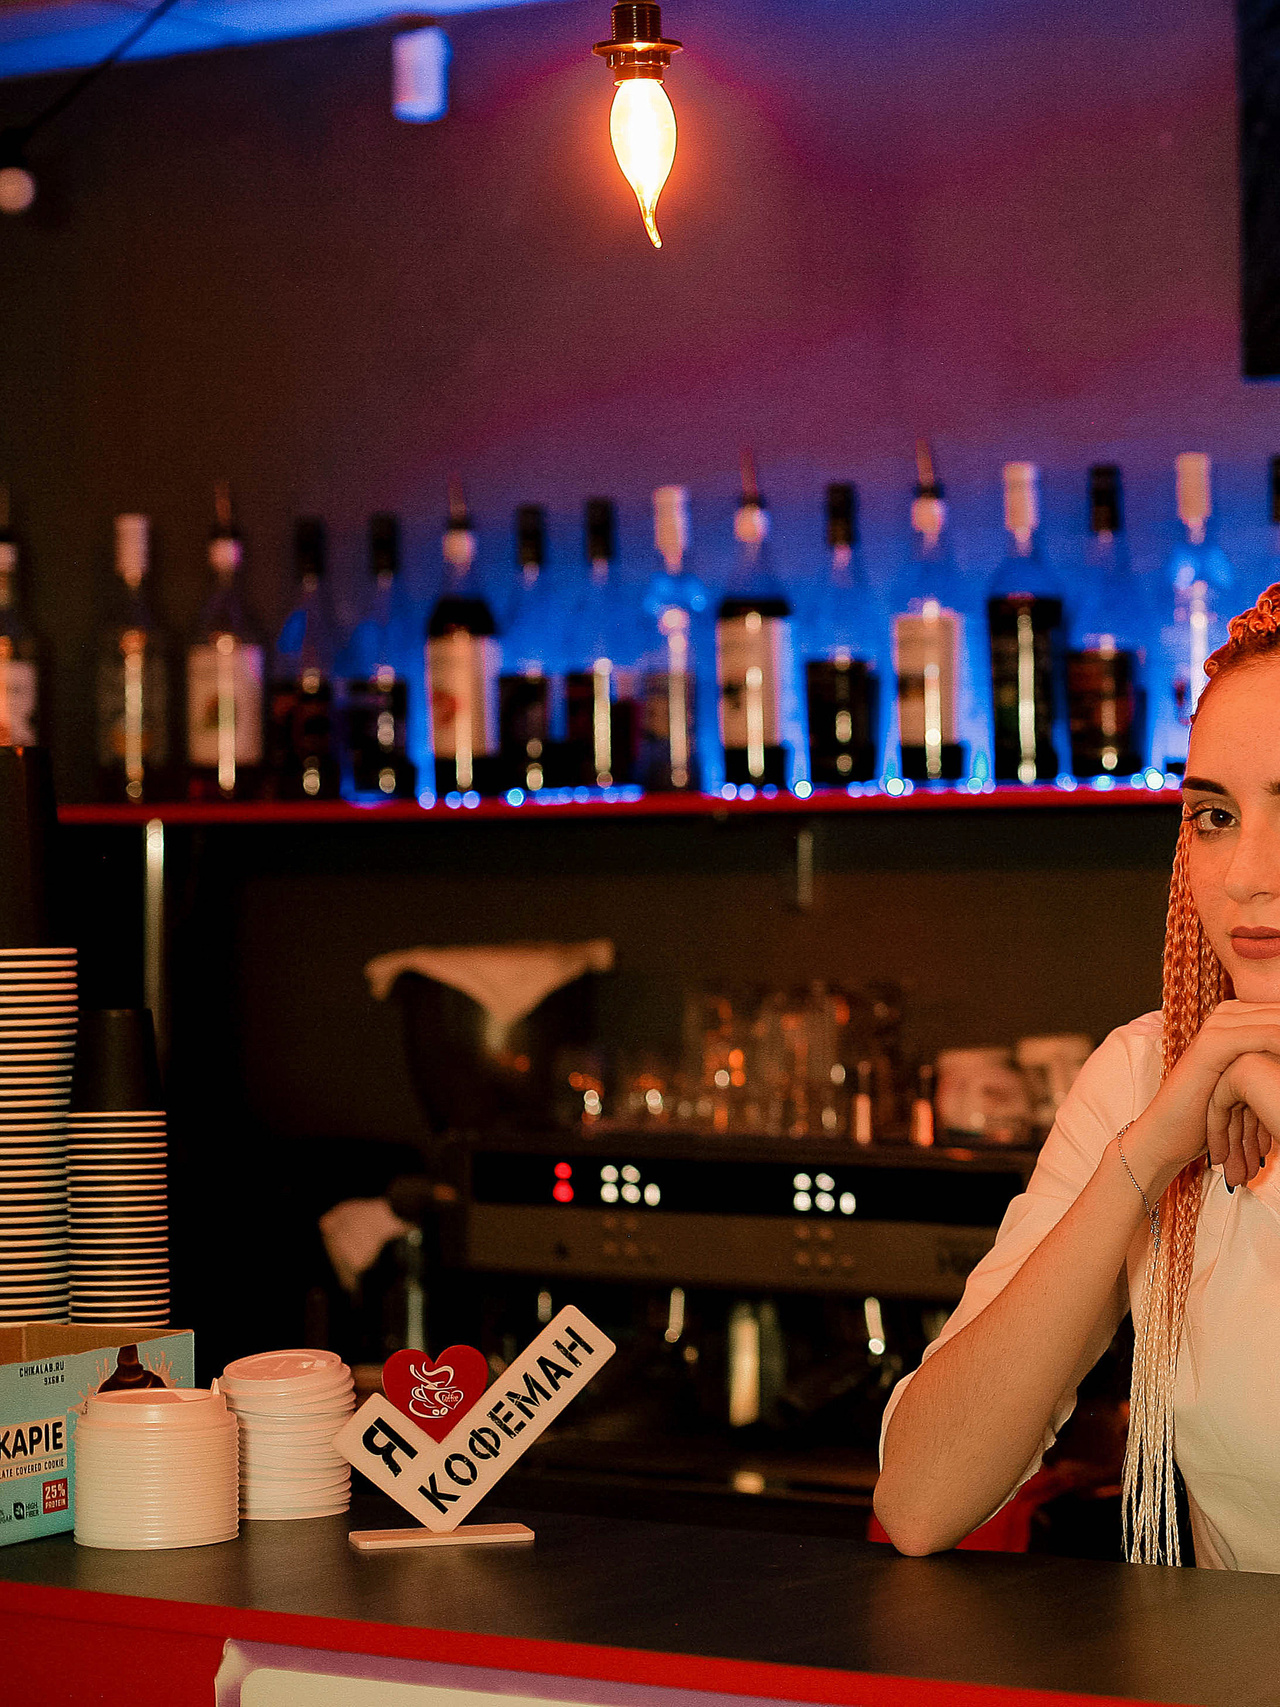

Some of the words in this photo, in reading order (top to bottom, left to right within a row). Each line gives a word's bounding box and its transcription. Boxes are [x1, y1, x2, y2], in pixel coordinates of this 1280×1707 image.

[19, 1360, 65, 1378] CHIKALAB.RU
[417, 1325, 595, 1515] КОФЕМАН
[361, 1416, 419, 1479] Я
[15, 1462, 42, 1476] COVERED
[44, 1457, 65, 1471] COOKIE
[44, 1482, 67, 1500] 25%
[26, 1501, 39, 1511] HIGH
[44, 1498, 67, 1510] PROTEIN
[26, 1509, 40, 1519] FIBER
